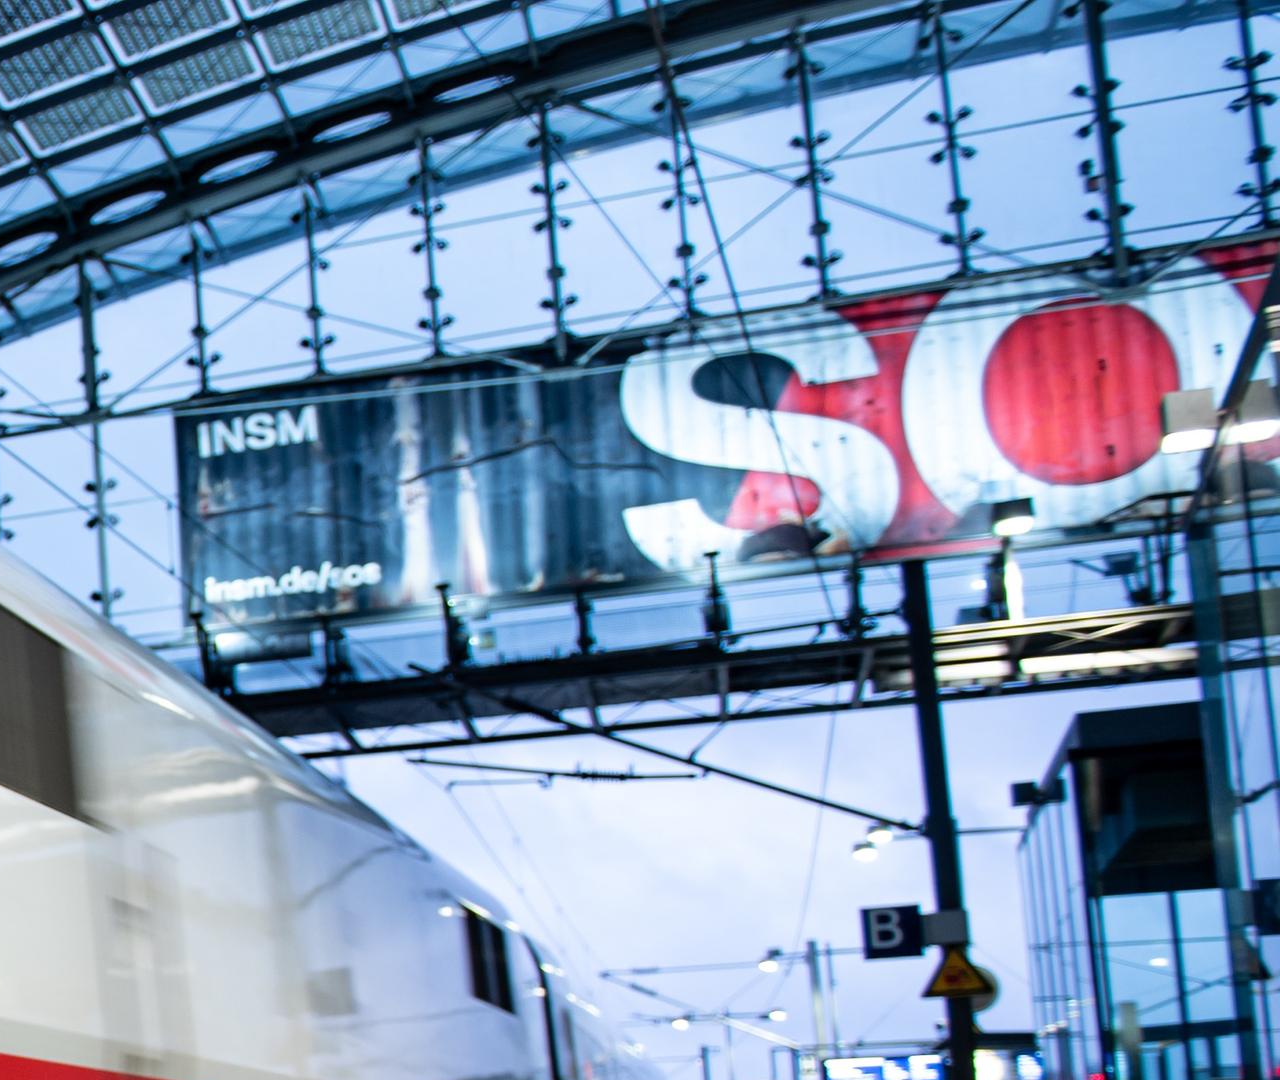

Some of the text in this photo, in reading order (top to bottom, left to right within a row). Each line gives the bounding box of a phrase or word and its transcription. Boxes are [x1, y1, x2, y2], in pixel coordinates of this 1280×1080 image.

[197, 405, 319, 459] INSM
[621, 250, 1280, 582] SO
[869, 909, 904, 949] B
